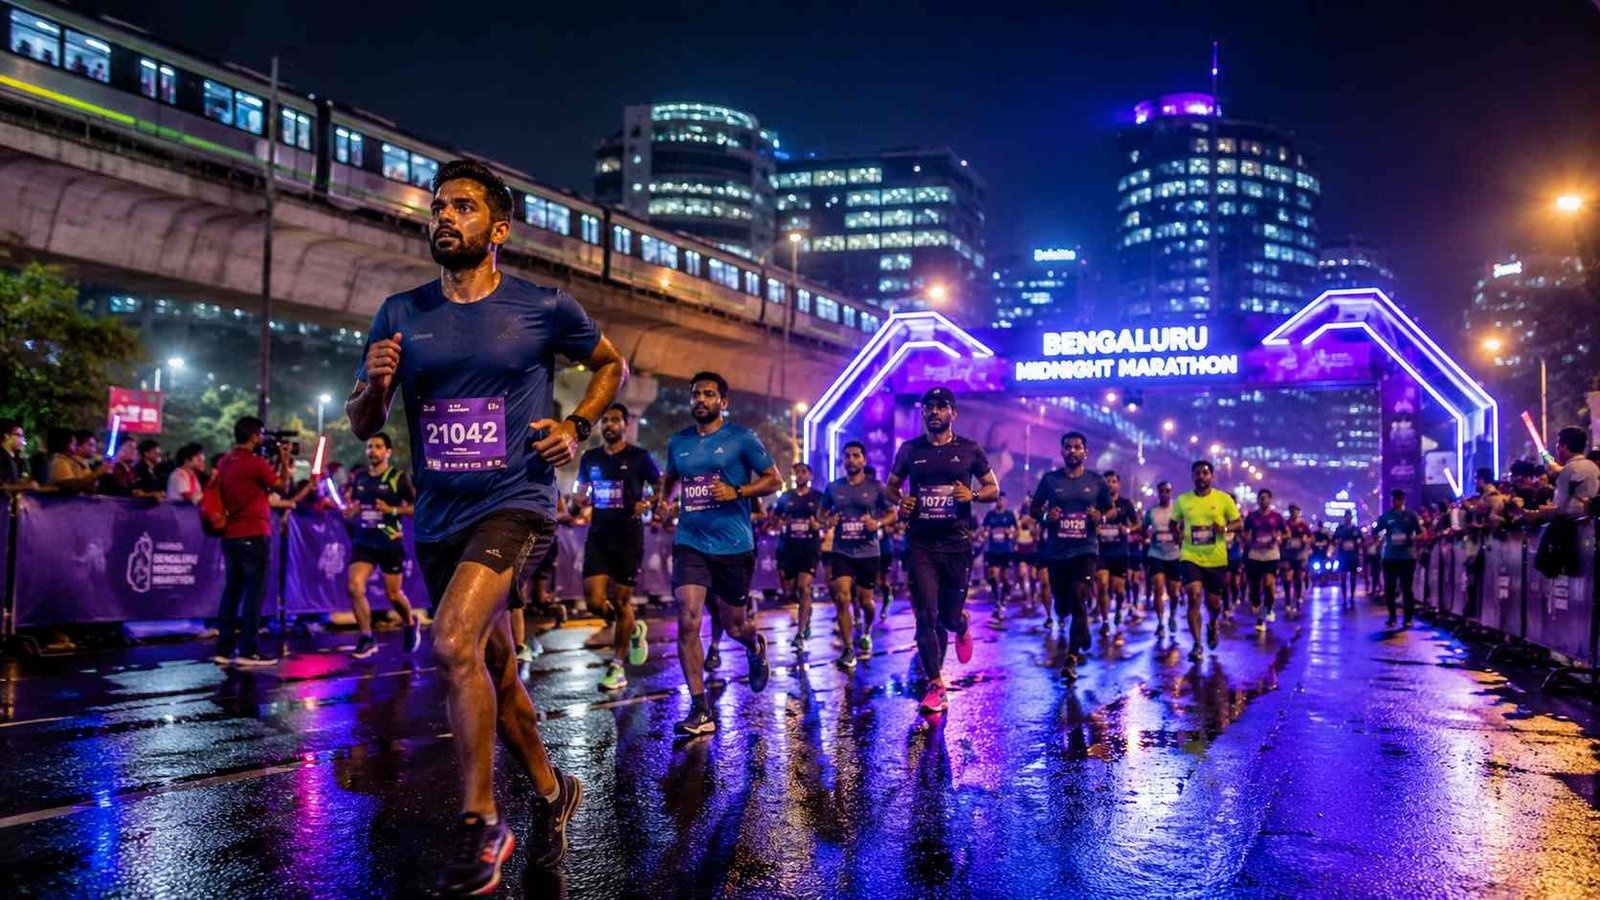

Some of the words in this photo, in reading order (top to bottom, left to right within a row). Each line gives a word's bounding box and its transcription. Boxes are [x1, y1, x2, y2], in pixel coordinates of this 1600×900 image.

[1043, 326, 1208, 356] BENGALURU
[1016, 359, 1114, 381] MIDNIGHT
[1118, 355, 1238, 377] MARATHON
[426, 421, 498, 444] 21042
